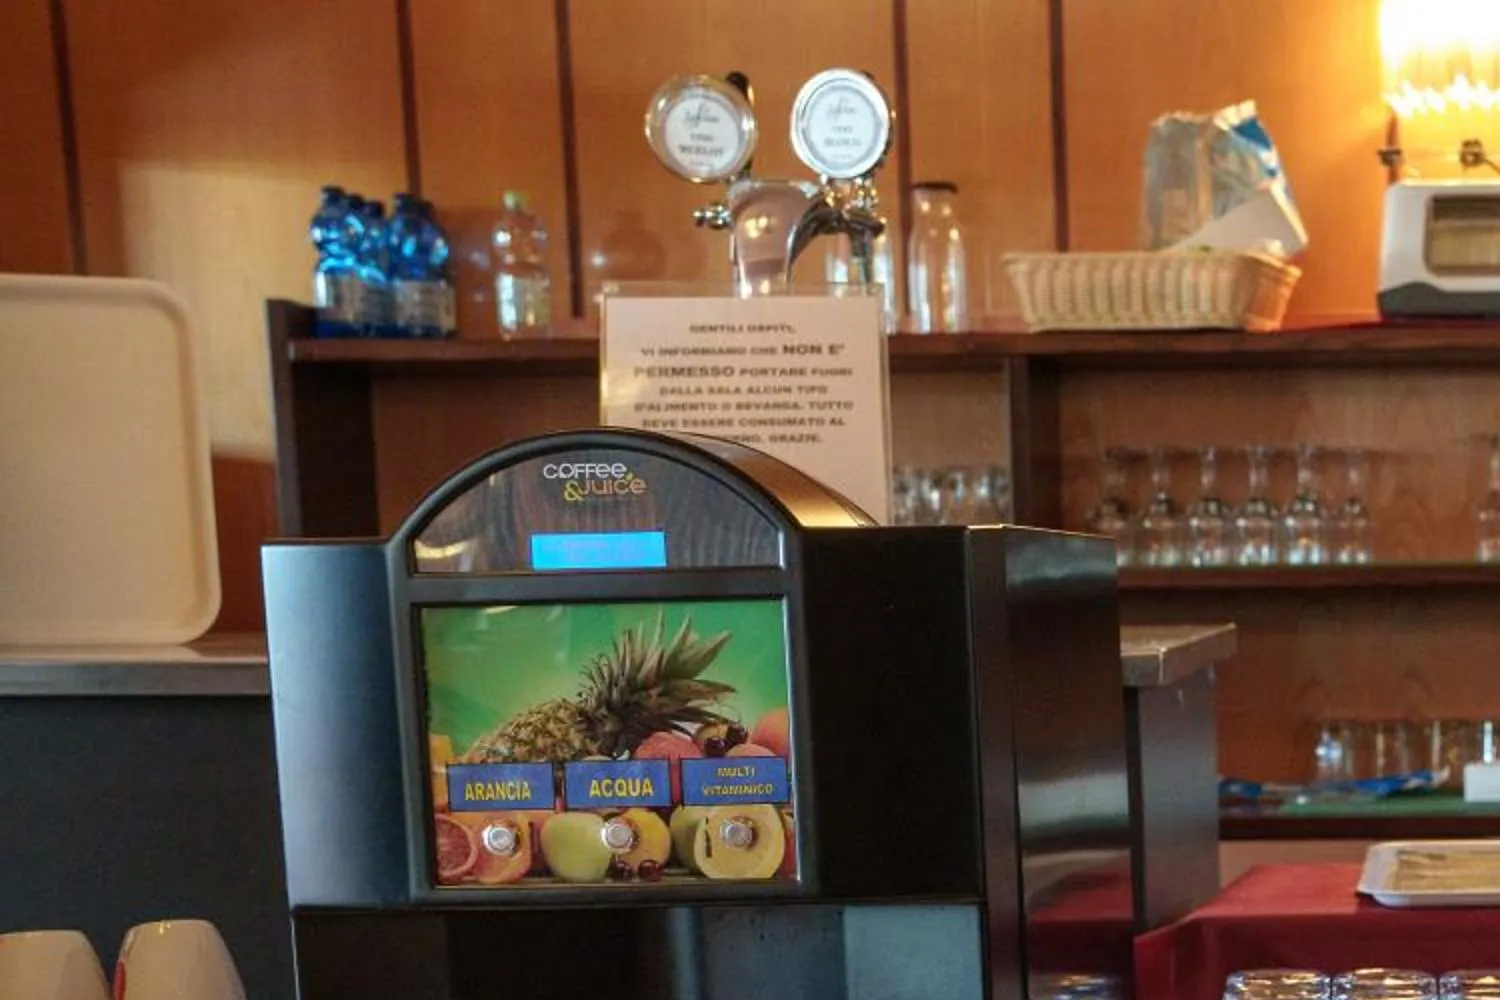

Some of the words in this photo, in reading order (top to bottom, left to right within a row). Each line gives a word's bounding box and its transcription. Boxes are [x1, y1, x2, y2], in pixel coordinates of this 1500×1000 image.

[688, 324, 744, 334] GENTILI
[782, 343, 823, 355] NON
[634, 366, 735, 378] PERMESSO
[739, 367, 808, 377] PORTARE
[811, 367, 854, 376] FUORI
[659, 385, 703, 396] DALLA
[707, 385, 742, 395] SALA
[746, 385, 793, 395] ALCUN
[797, 385, 829, 395] TIPO
[808, 400, 854, 411] TUTTO
[642, 418, 678, 428] DEVE
[682, 418, 735, 428] ESSERE
[738, 417, 826, 428] CONSUMATO
[829, 417, 846, 427] AL
[716, 767, 756, 778] MULTI
[464, 781, 533, 802] ARANCIA
[588, 778, 655, 798] ACQUA
[702, 782, 774, 797] VITAMINICO
